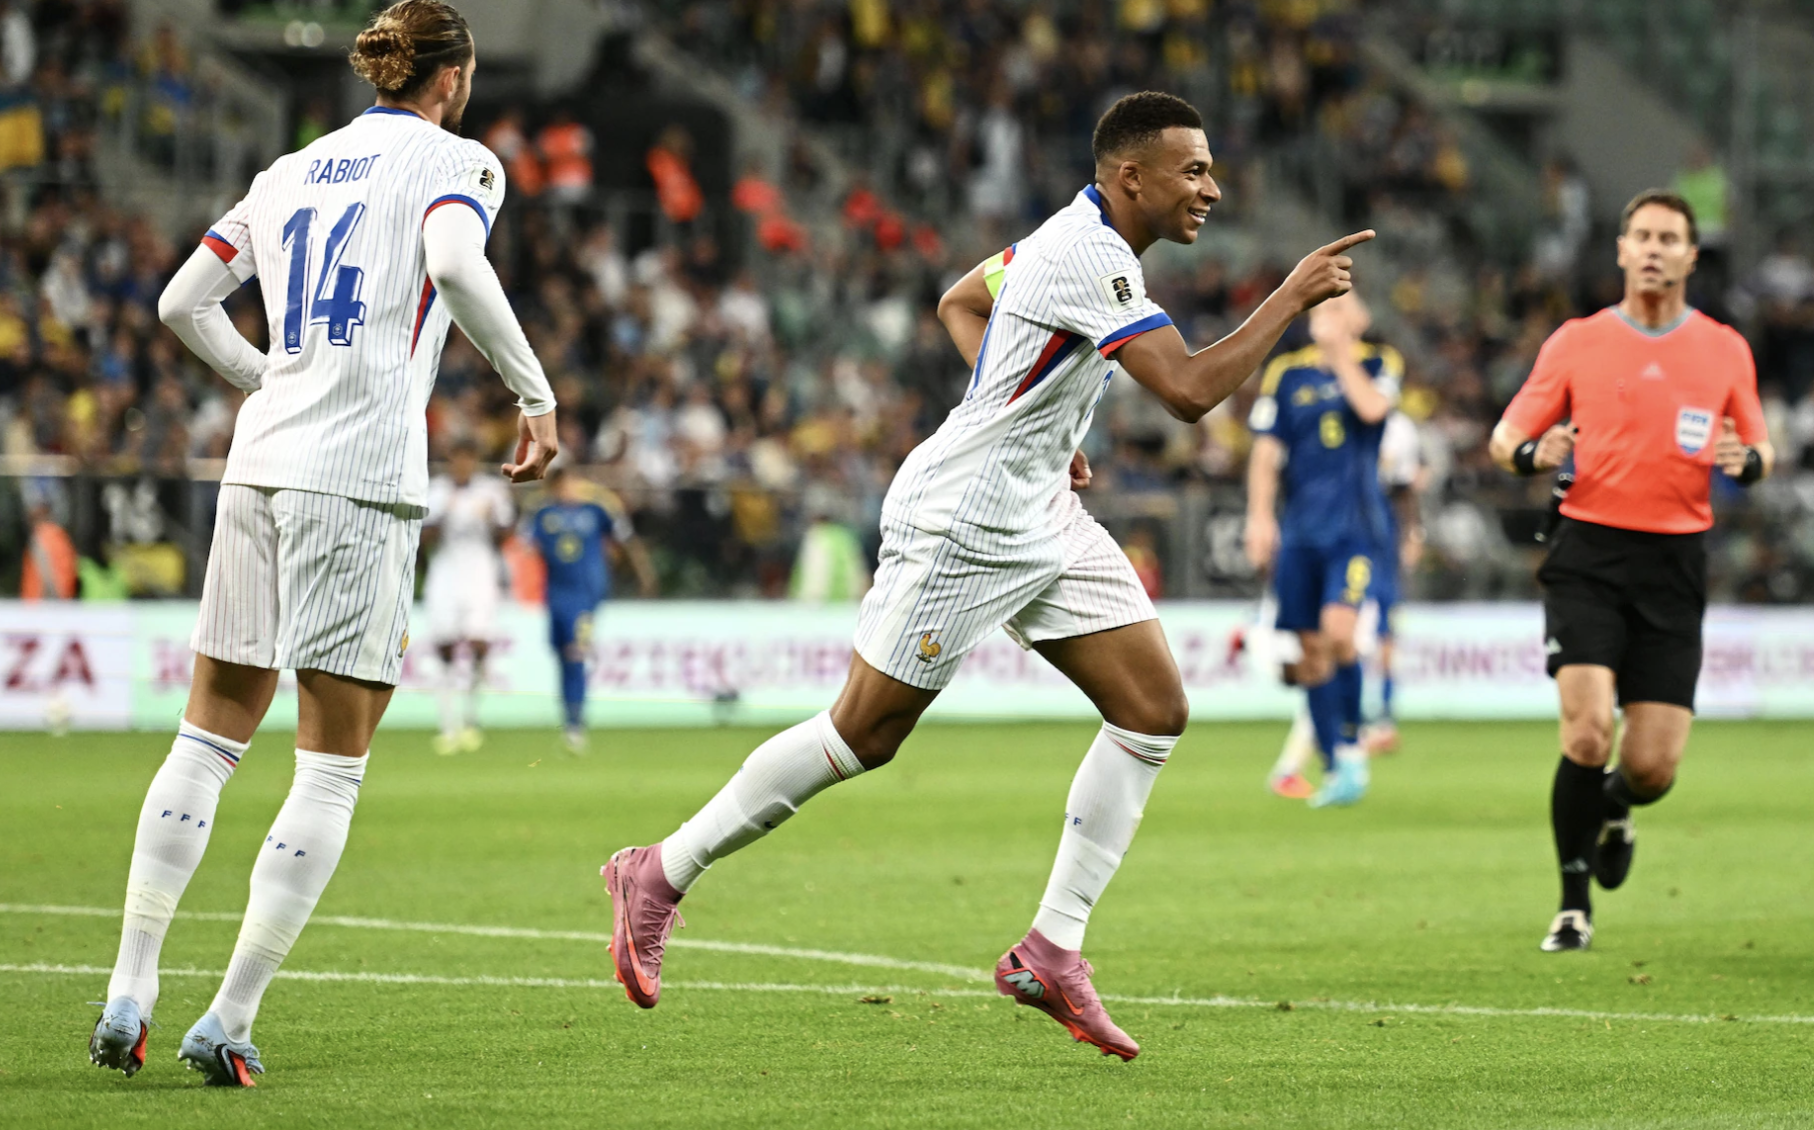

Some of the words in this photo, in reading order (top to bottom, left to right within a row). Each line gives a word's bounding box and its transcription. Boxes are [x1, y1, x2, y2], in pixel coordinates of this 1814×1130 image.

[304, 154, 381, 185] RABIOT
[282, 201, 366, 354] 14
[4, 634, 97, 692] ZA
